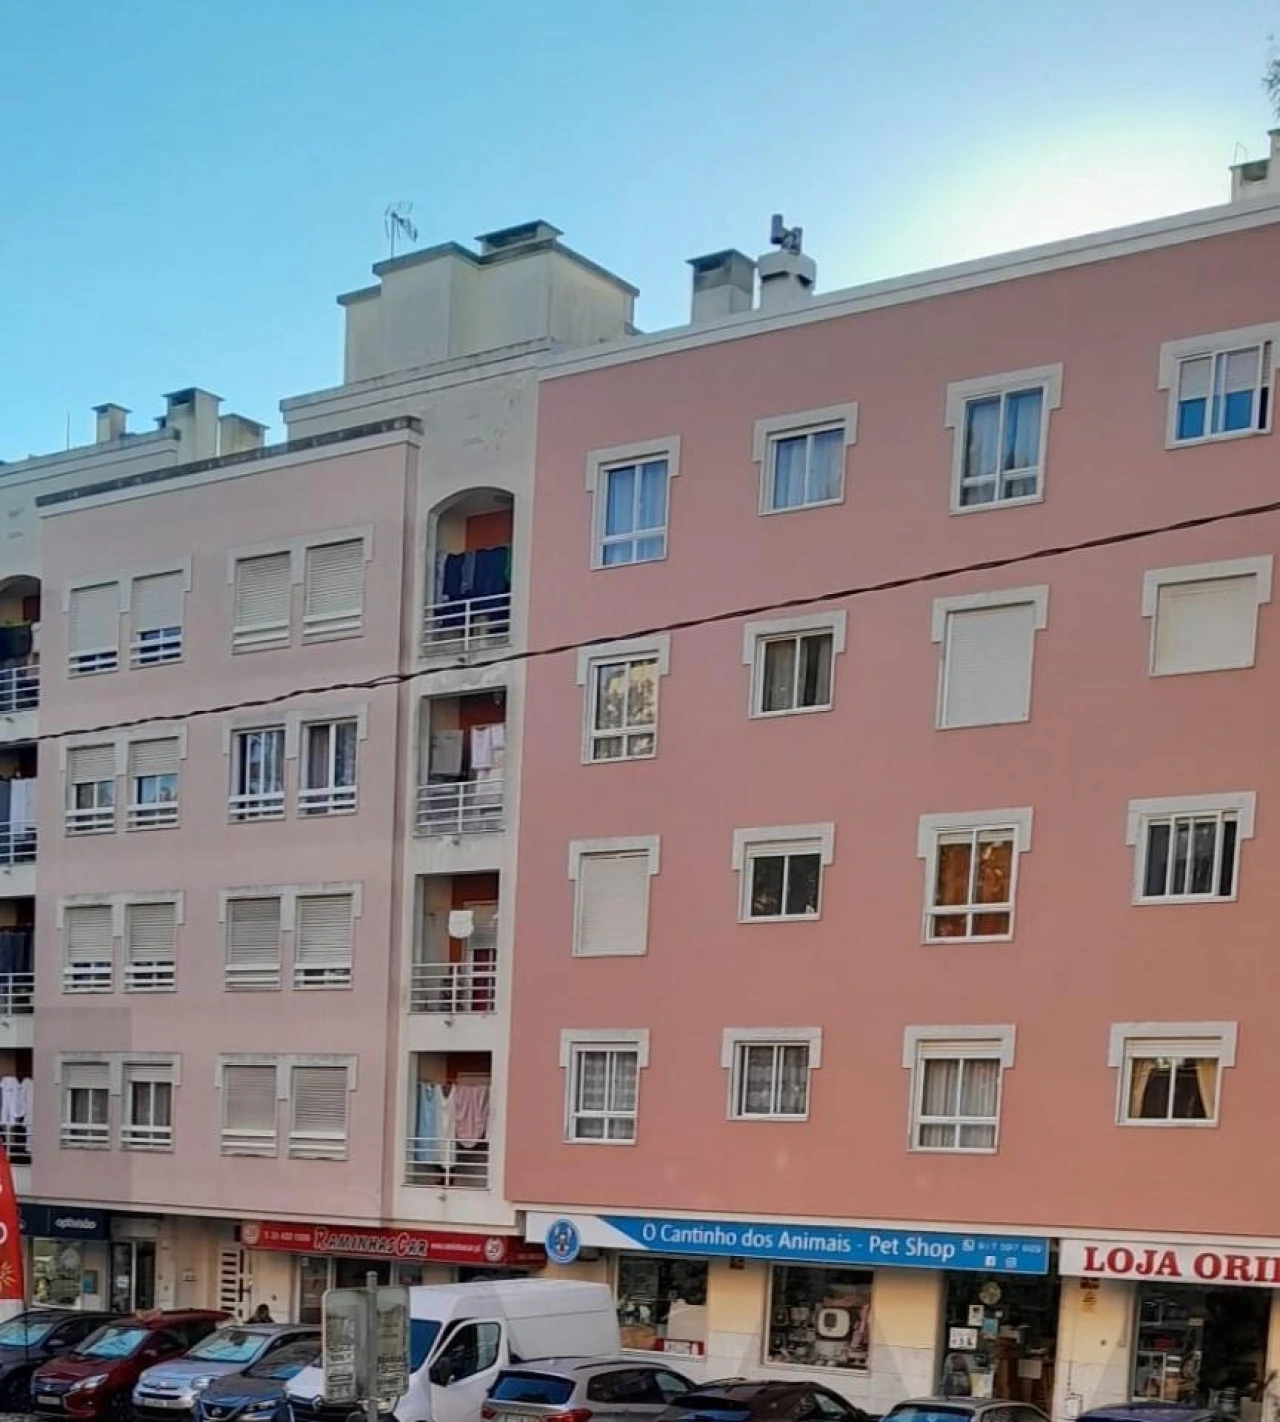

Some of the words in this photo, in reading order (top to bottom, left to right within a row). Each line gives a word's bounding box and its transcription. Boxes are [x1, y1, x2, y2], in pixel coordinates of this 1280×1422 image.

[642, 1223, 656, 1241] O
[661, 1224, 737, 1246] Cantinho
[741, 1228, 773, 1248] dos
[778, 1231, 851, 1253] Animais
[869, 1235, 899, 1256] Pet
[905, 1236, 956, 1262] Shop
[1083, 1246, 1182, 1278] LOJA
